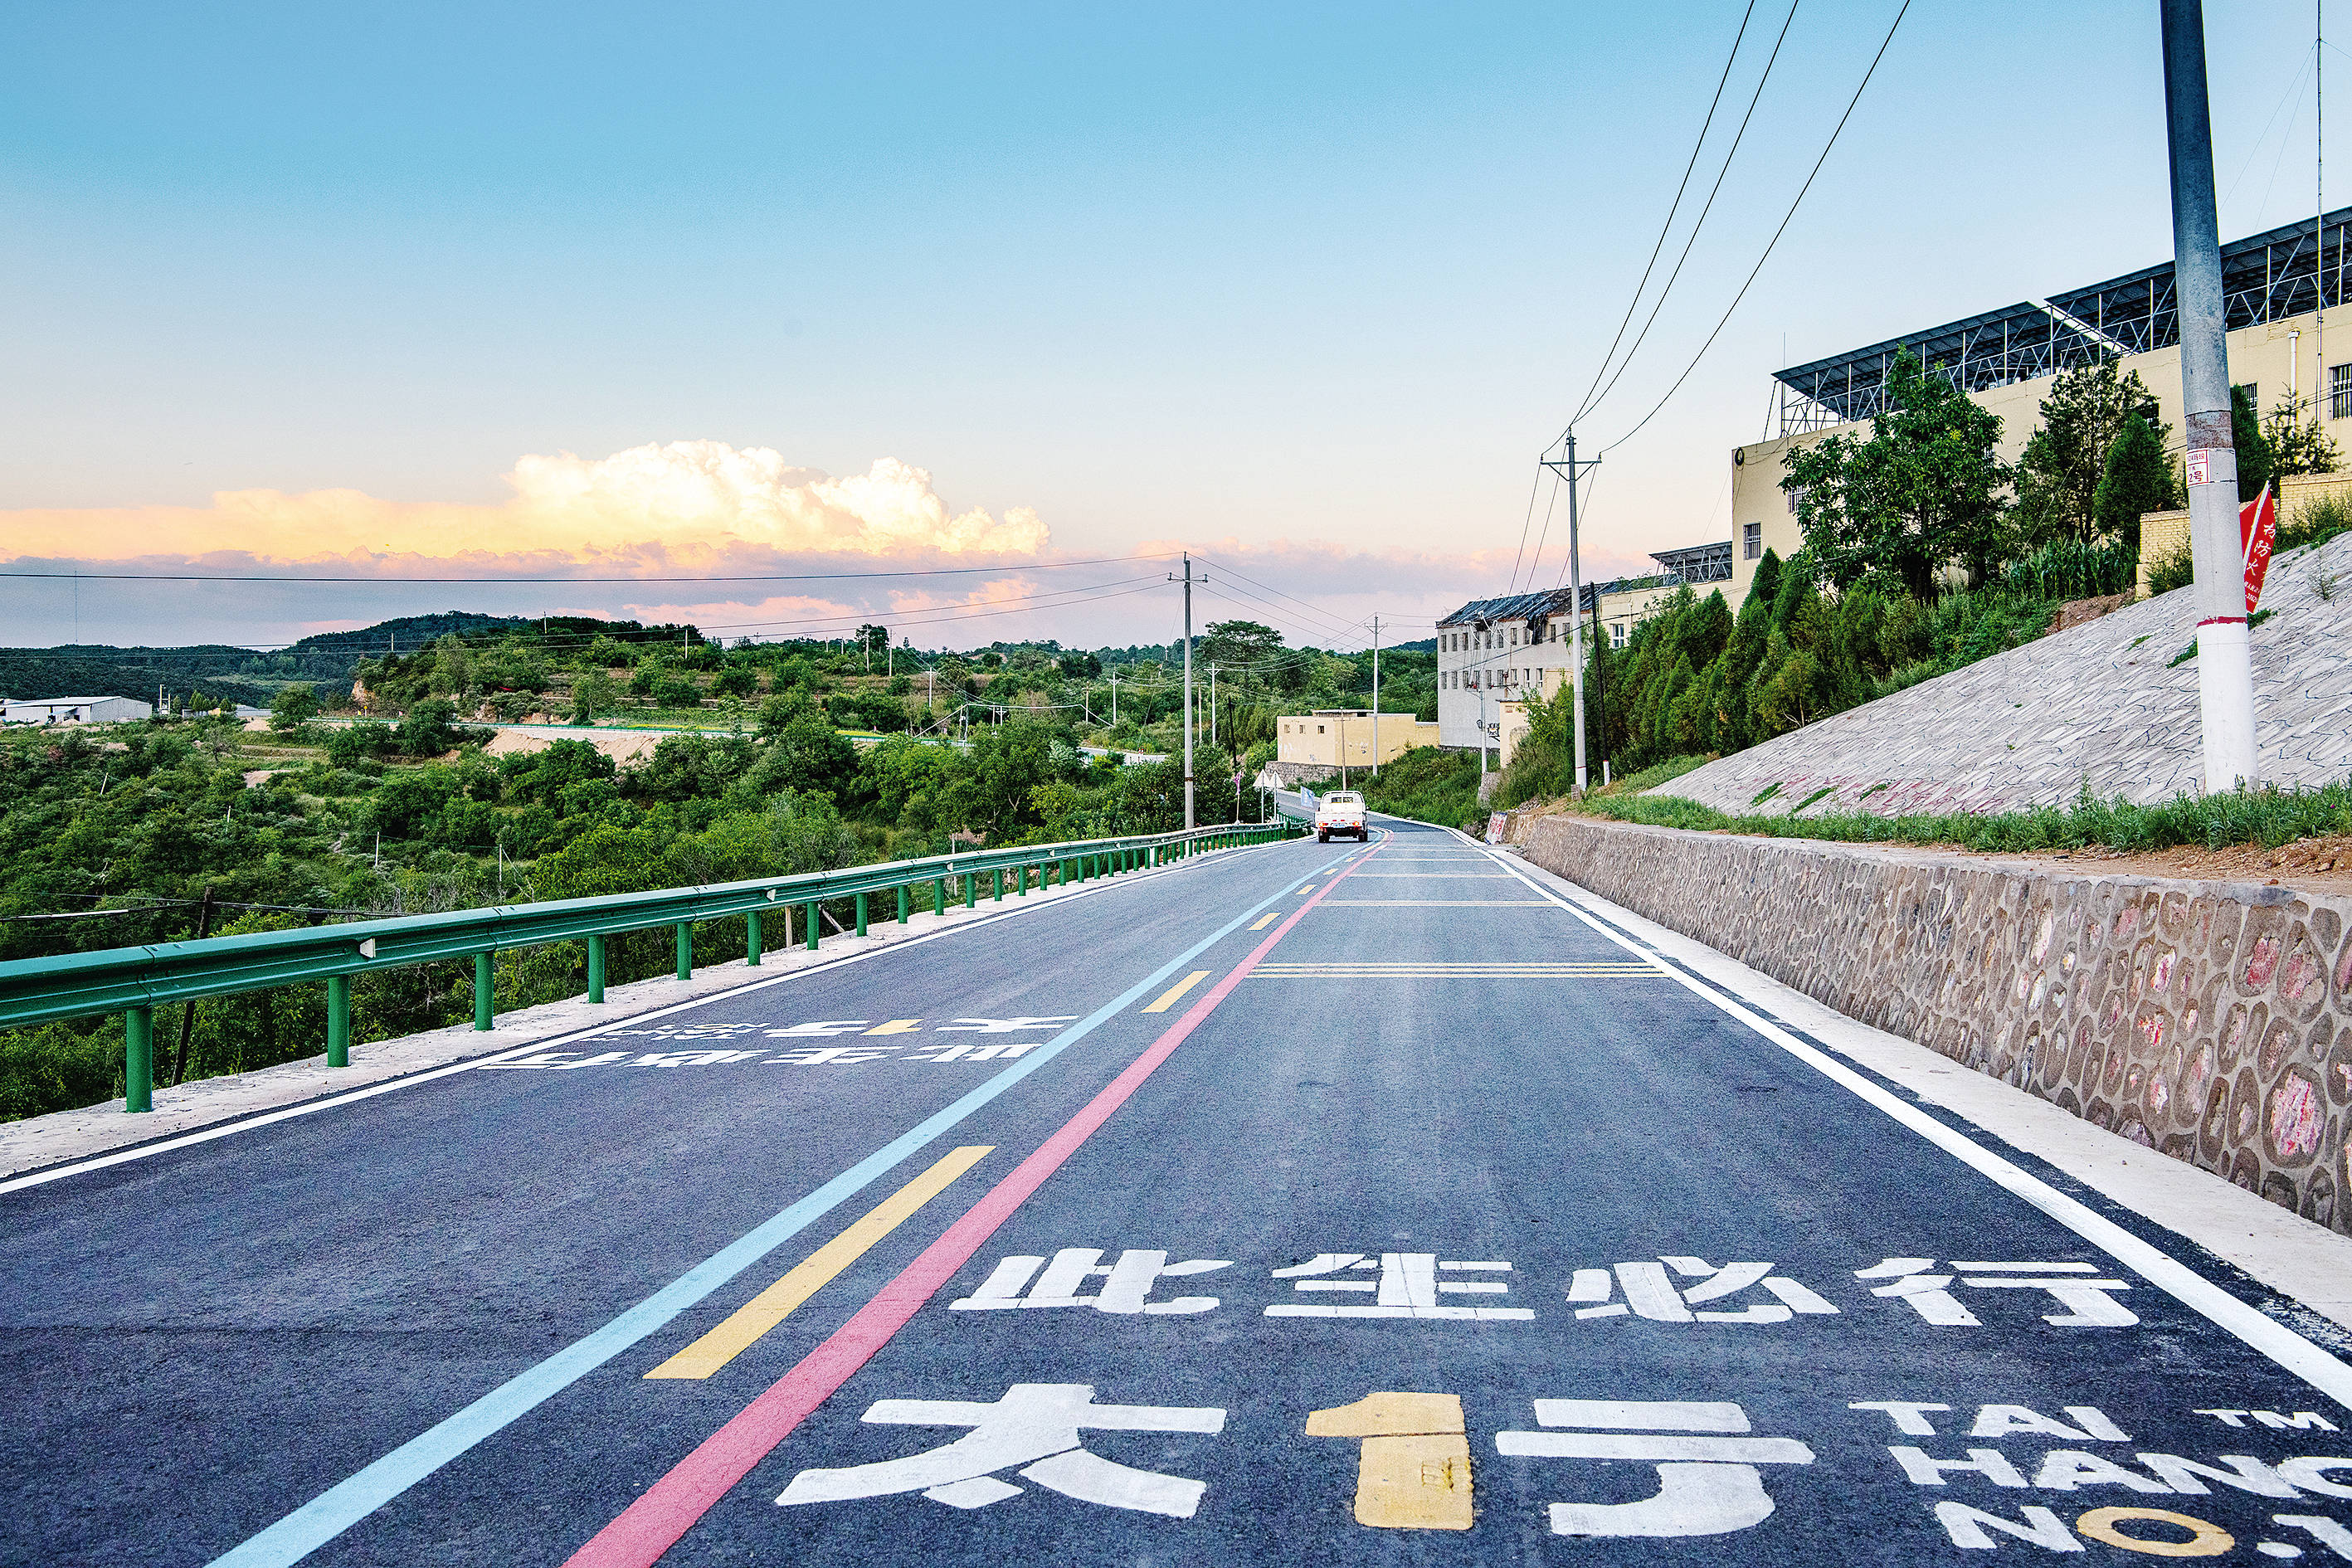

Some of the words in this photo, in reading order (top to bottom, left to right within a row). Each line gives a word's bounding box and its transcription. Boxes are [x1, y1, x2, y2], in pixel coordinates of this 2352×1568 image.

[948, 1248, 2140, 1327] 此生必行
[1848, 1401, 2133, 1442] TAI
